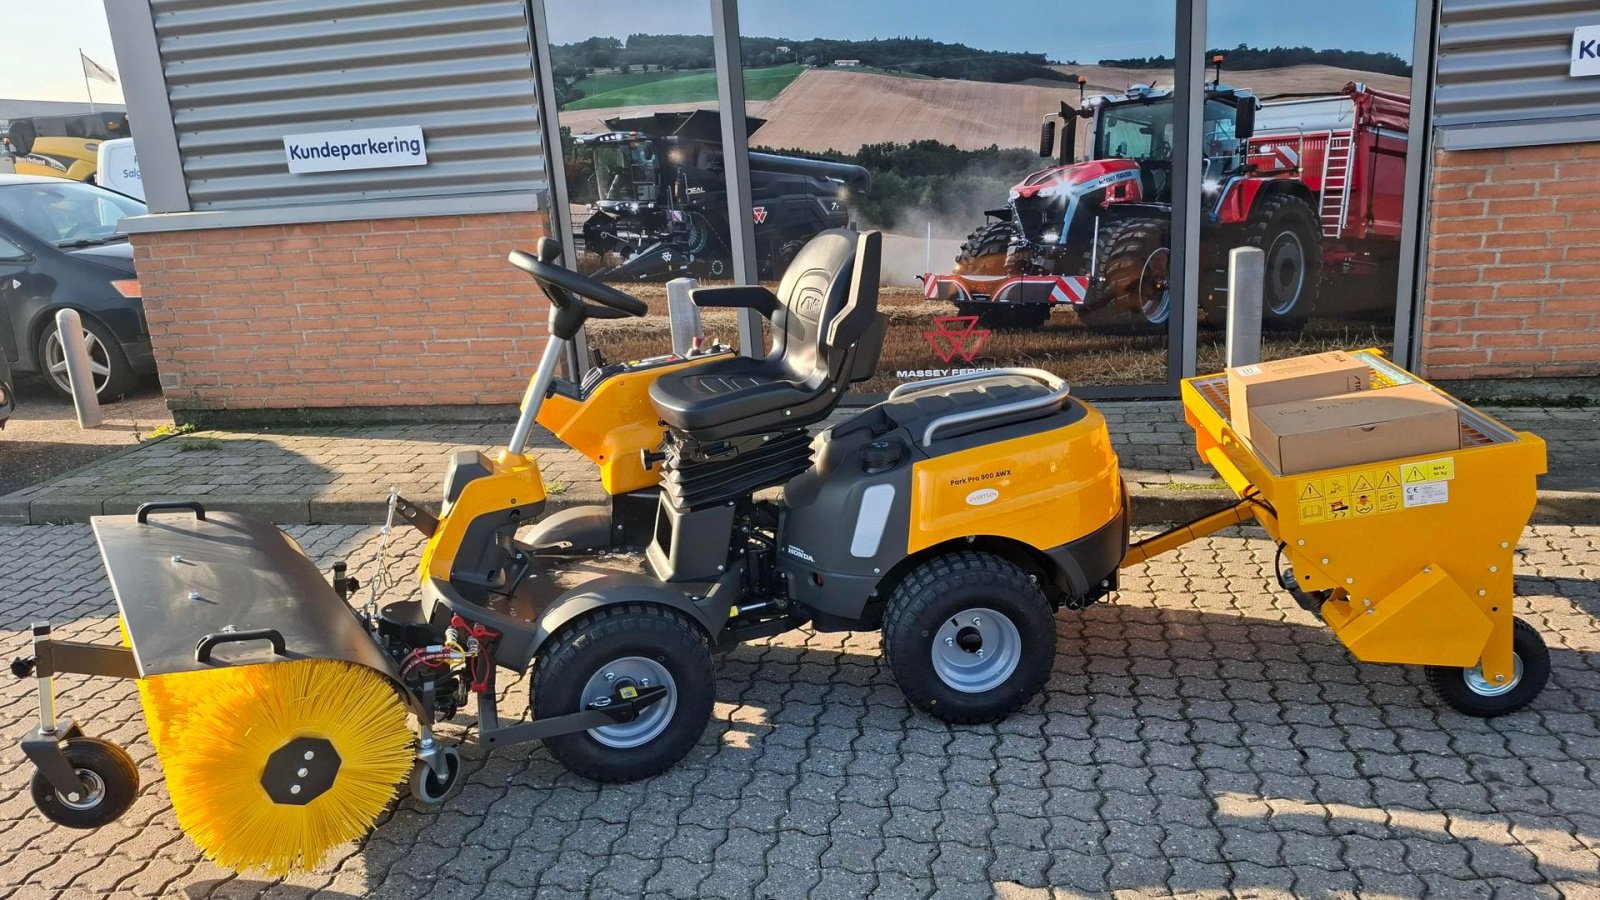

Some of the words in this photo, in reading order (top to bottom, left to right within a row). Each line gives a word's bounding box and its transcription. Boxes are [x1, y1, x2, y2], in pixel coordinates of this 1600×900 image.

[289, 136, 421, 161] Kundeparkering
[896, 369, 949, 378] MASSEY
[950, 478, 967, 486] Park
[967, 475, 980, 483] Pro
[980, 472, 994, 481] 900
[995, 469, 1012, 478] AWX
[788, 547, 816, 563] HONDA
